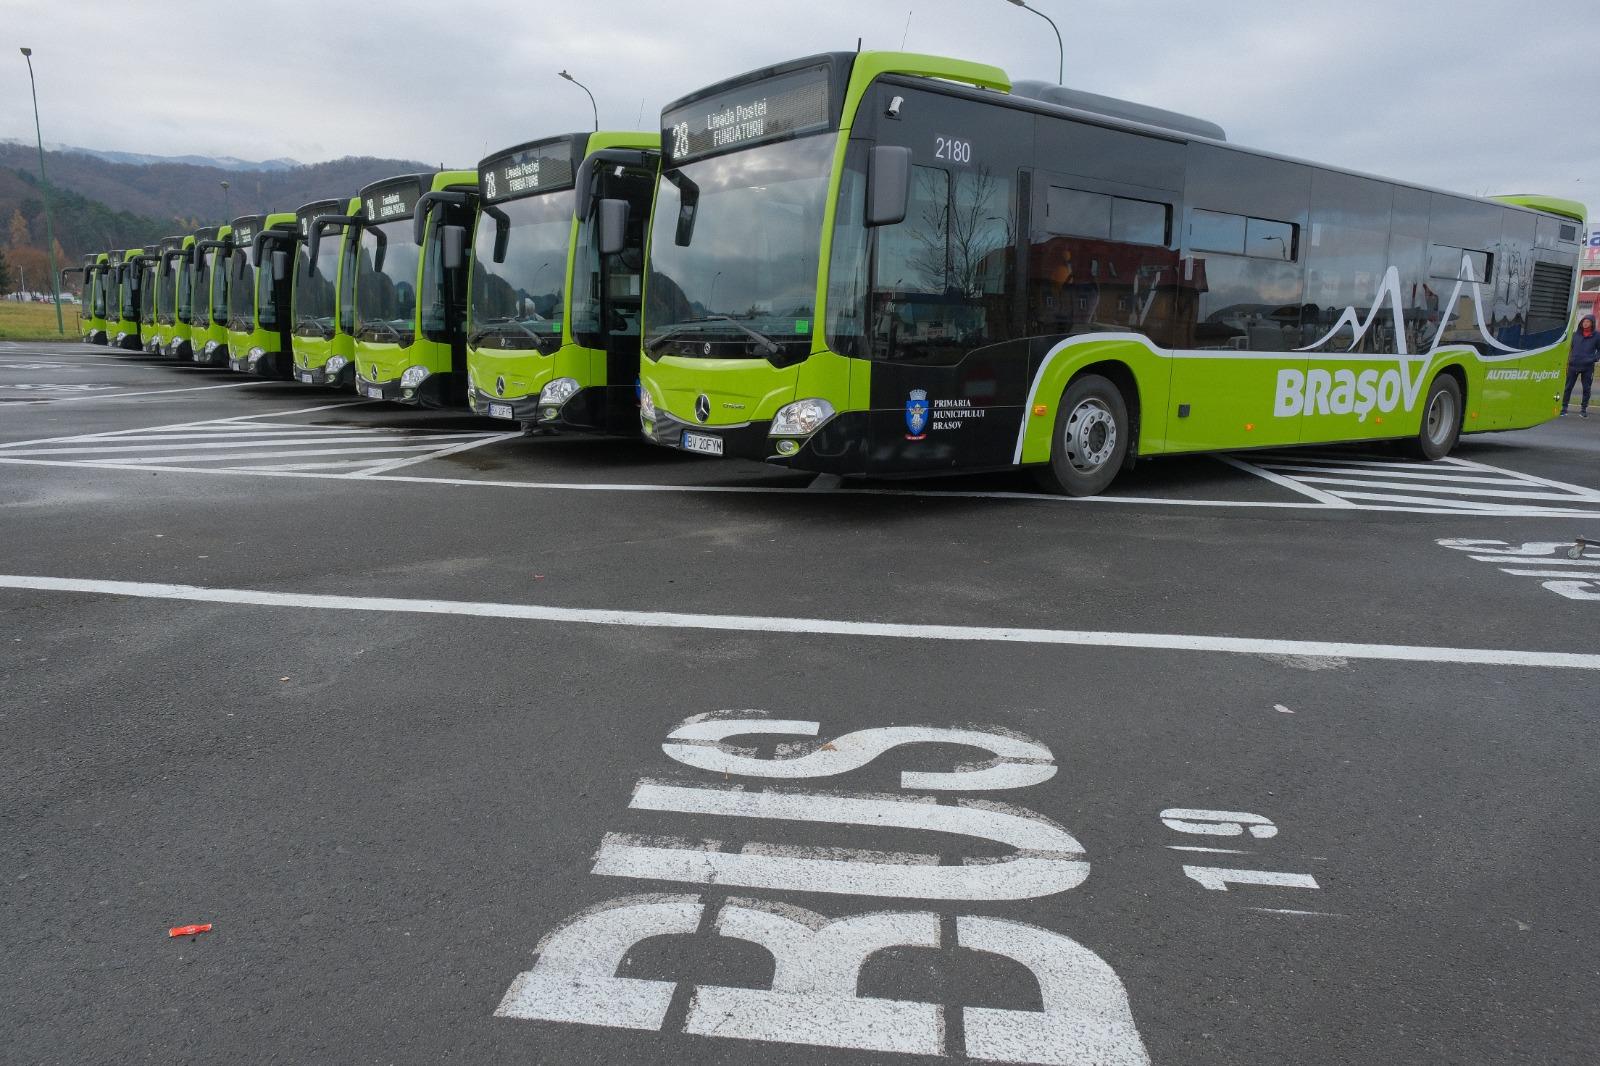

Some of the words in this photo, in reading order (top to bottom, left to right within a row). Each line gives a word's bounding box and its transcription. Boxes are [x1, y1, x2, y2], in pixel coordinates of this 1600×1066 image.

[707, 108, 735, 130] Livada
[736, 98, 767, 121] Postei
[673, 121, 689, 159] 28
[714, 119, 764, 147] FUNDATURII
[935, 137, 970, 163] 2180
[1530, 369, 1560, 382] hybrid
[933, 409, 985, 419] MUNICIPIULUI
[688, 435, 697, 449] BV
[1159, 808, 1320, 891] 19
[493, 708, 1151, 1066] BUS
